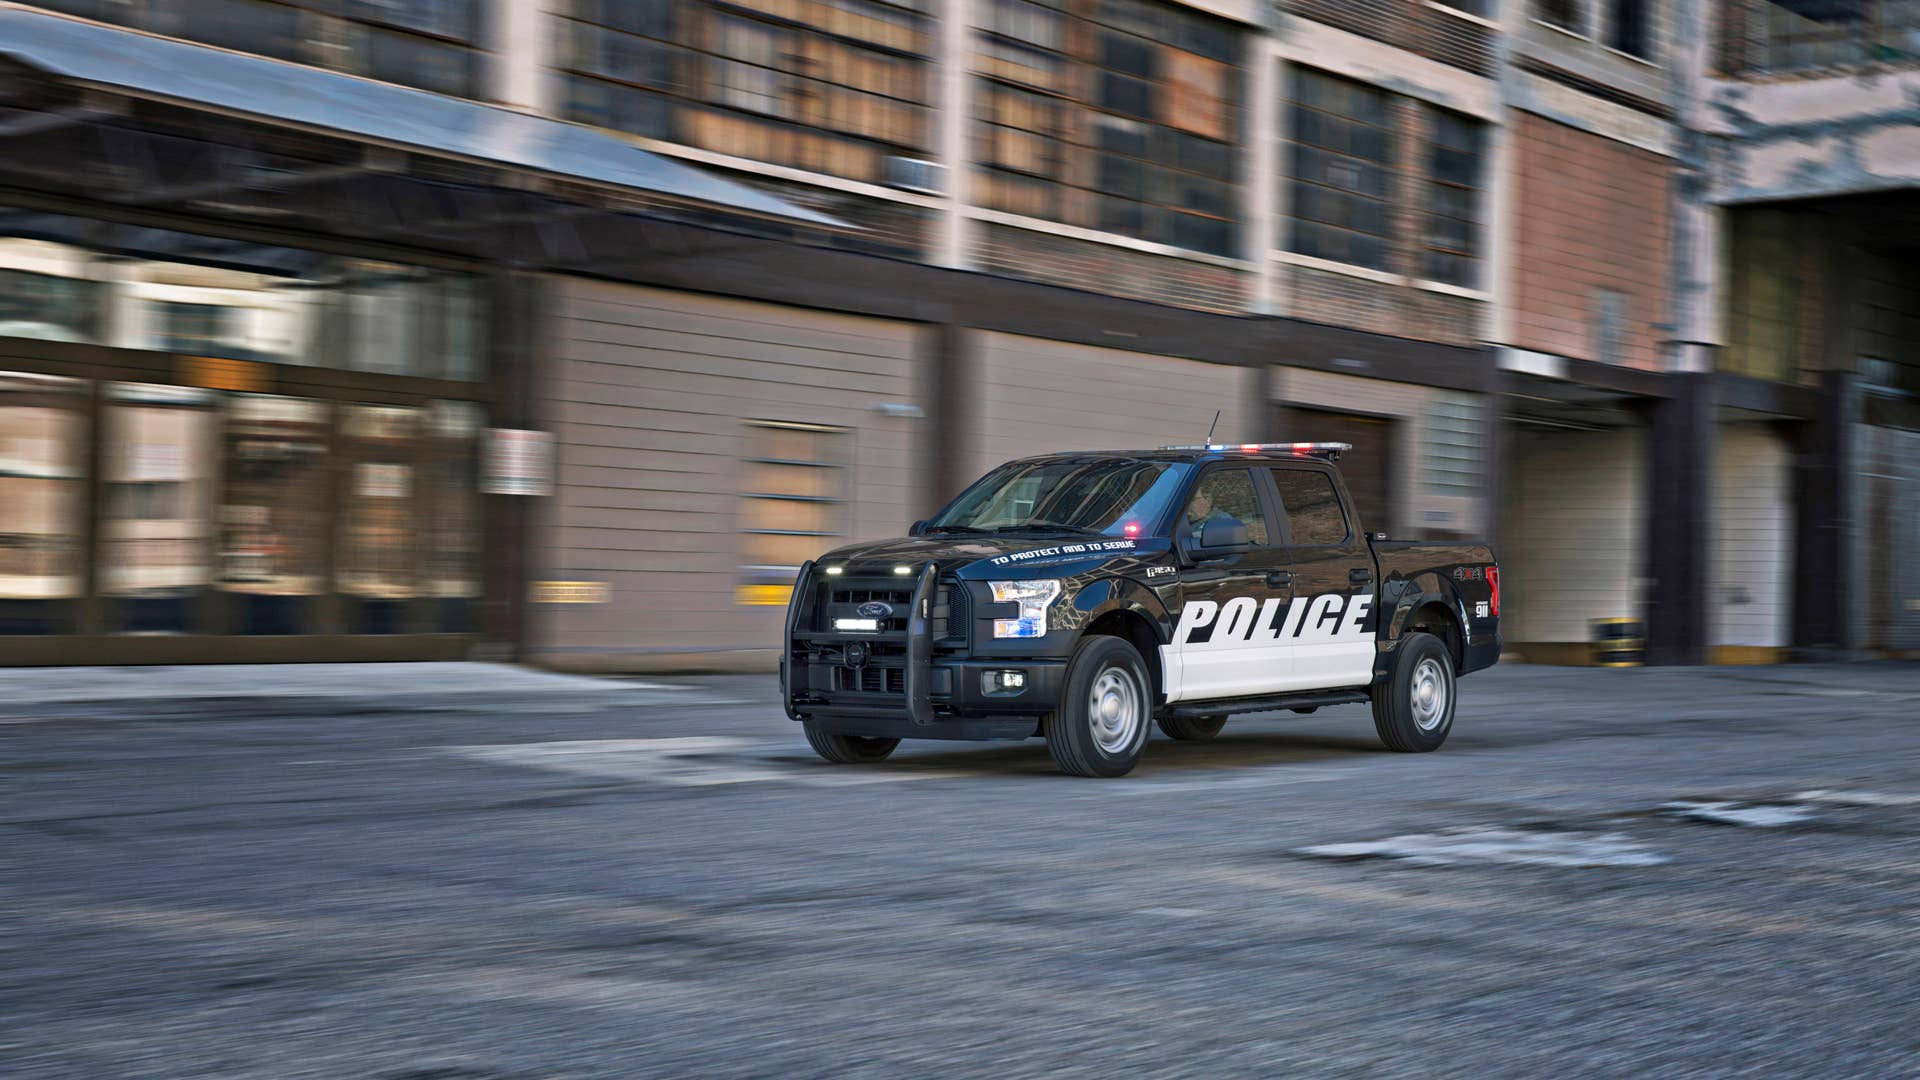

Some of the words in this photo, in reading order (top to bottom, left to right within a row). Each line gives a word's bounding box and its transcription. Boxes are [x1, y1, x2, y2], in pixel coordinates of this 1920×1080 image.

[991, 557, 1009, 565] TO
[1010, 547, 1060, 561] PROTECT
[1062, 544, 1086, 554] AND
[1086, 543, 1101, 551] TO
[1103, 540, 1136, 550] SERVE
[1170, 593, 1375, 645] POLICE
[1475, 605, 1489, 618] 911
